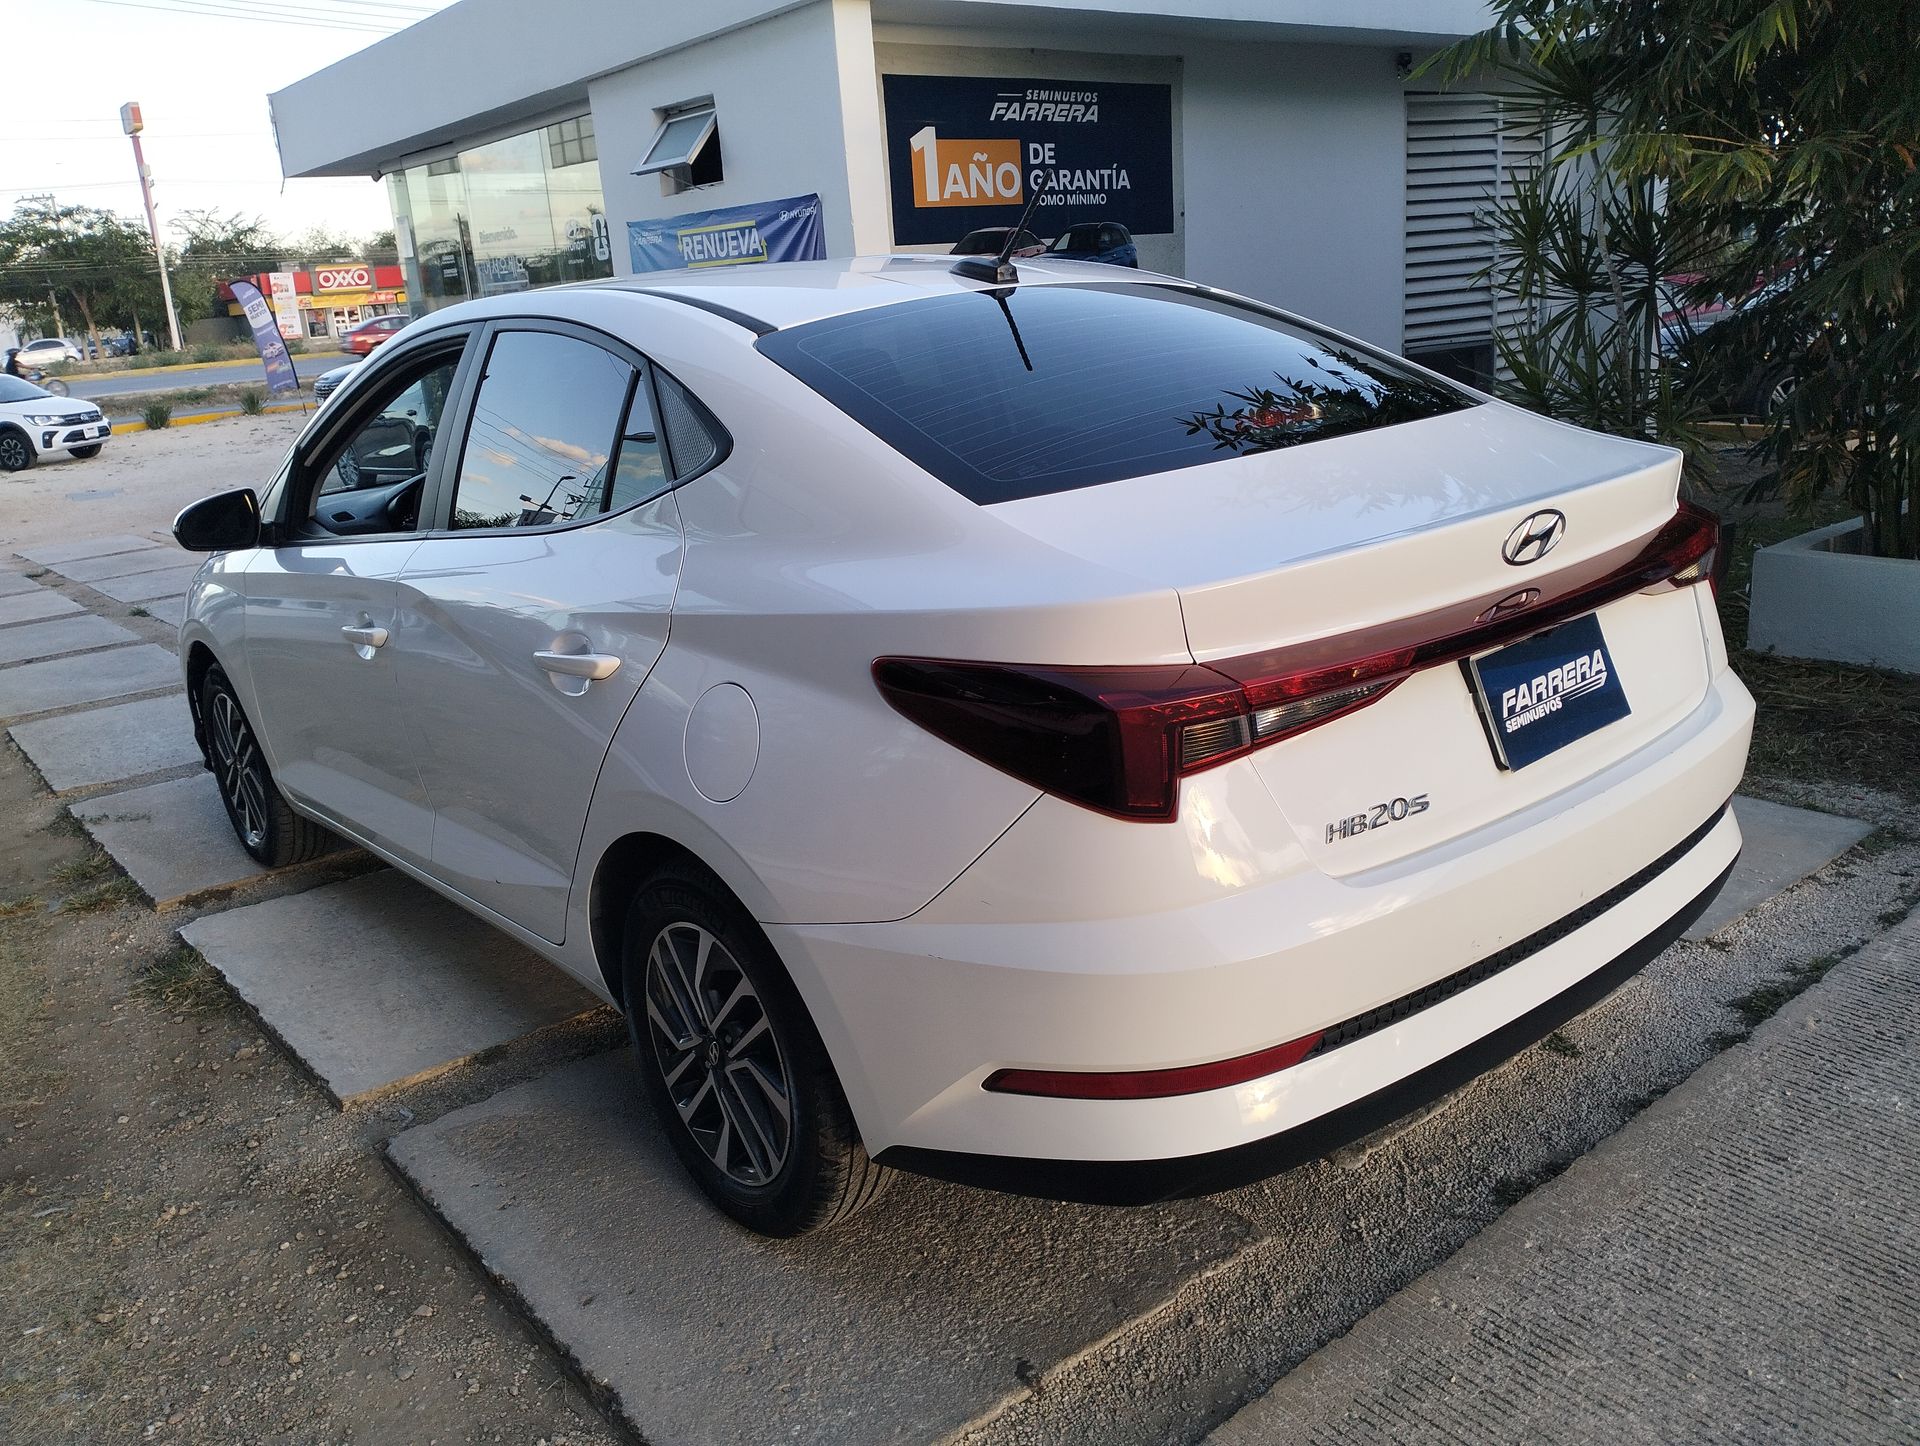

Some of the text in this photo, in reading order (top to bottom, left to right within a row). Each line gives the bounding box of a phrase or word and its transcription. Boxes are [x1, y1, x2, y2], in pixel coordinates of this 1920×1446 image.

[1026, 89, 1098, 103] SEMINUEVOS
[990, 102, 1099, 123] FARRERA
[910, 126, 1021, 202] 1 AÑO
[1029, 143, 1056, 165] DE
[1029, 163, 1131, 191] GARANTÍA
[1038, 191, 1107, 206] OMO MÍNIMO
[682, 228, 763, 262] RENUEVA
[318, 268, 369, 289] OXXO
[1502, 648, 1607, 719] FARRERA
[1505, 697, 1563, 733] SEMINUEVOS
